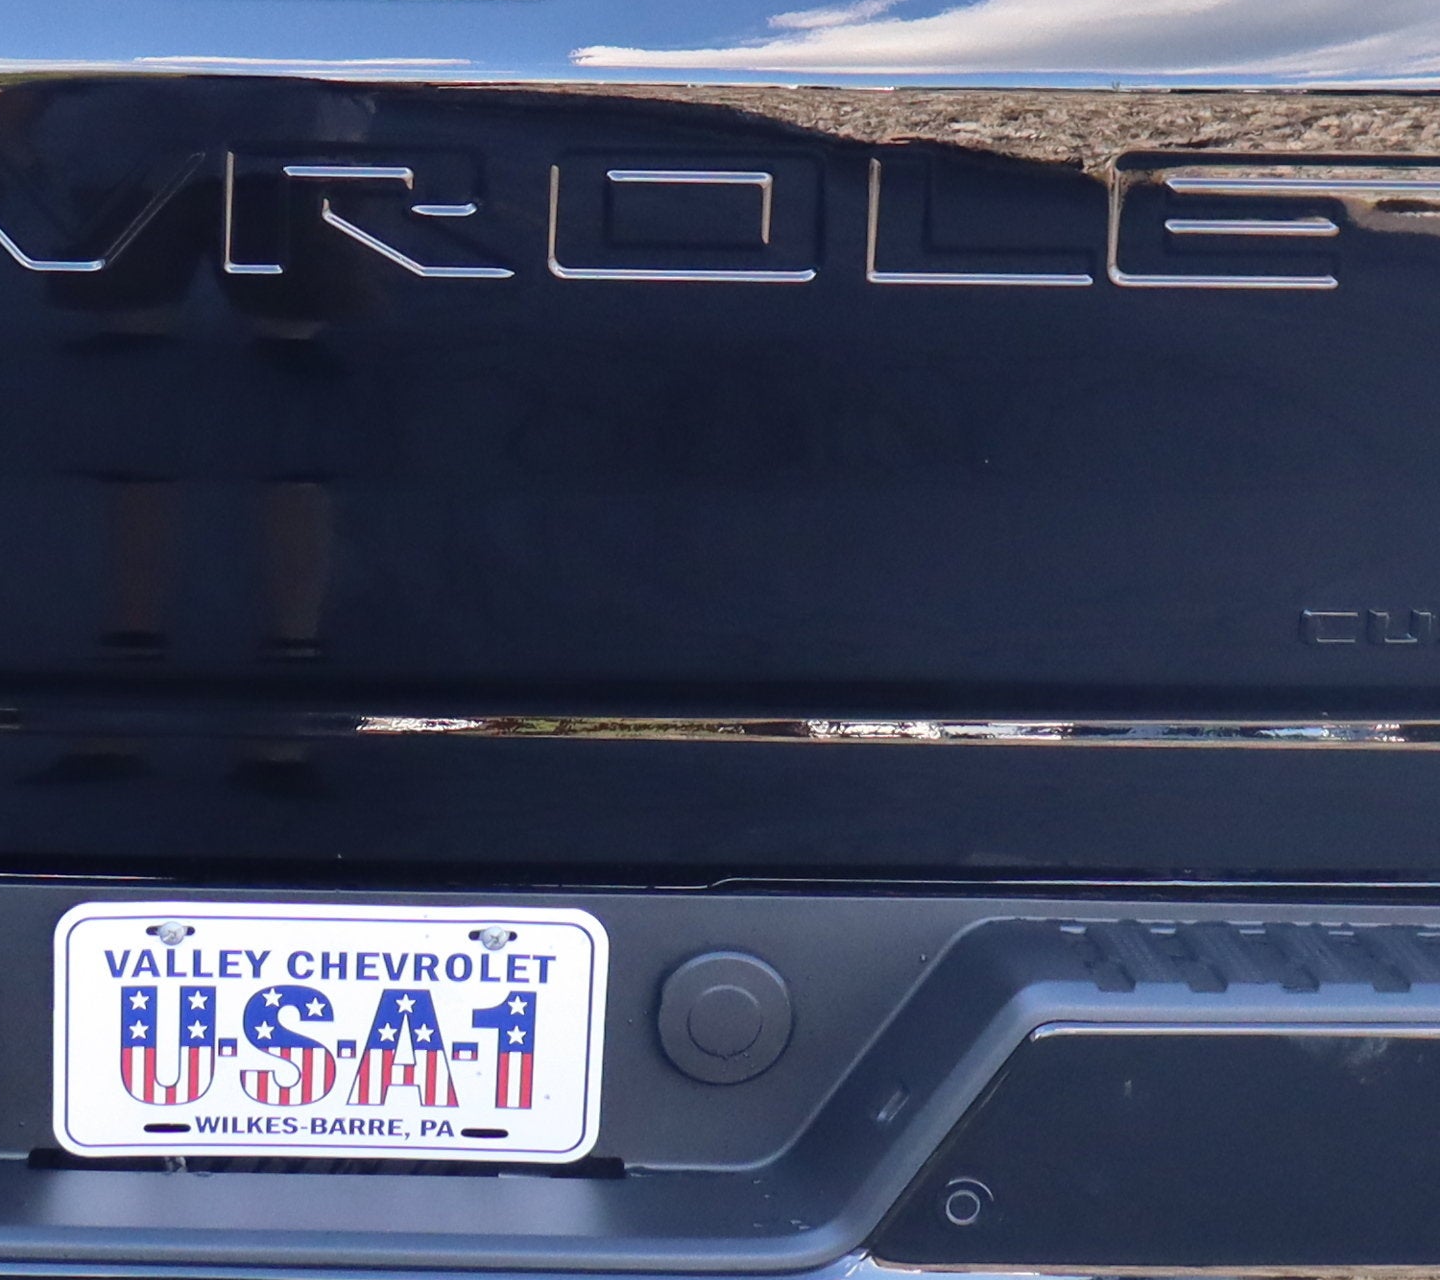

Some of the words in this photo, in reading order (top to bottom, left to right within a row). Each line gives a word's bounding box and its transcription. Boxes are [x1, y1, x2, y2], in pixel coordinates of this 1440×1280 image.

[104, 948, 271, 980] VALLEY
[286, 950, 557, 984] CHEVROLET
[195, 1115, 412, 1140] WILKES-BARRE,
[420, 1120, 455, 1139] PA
